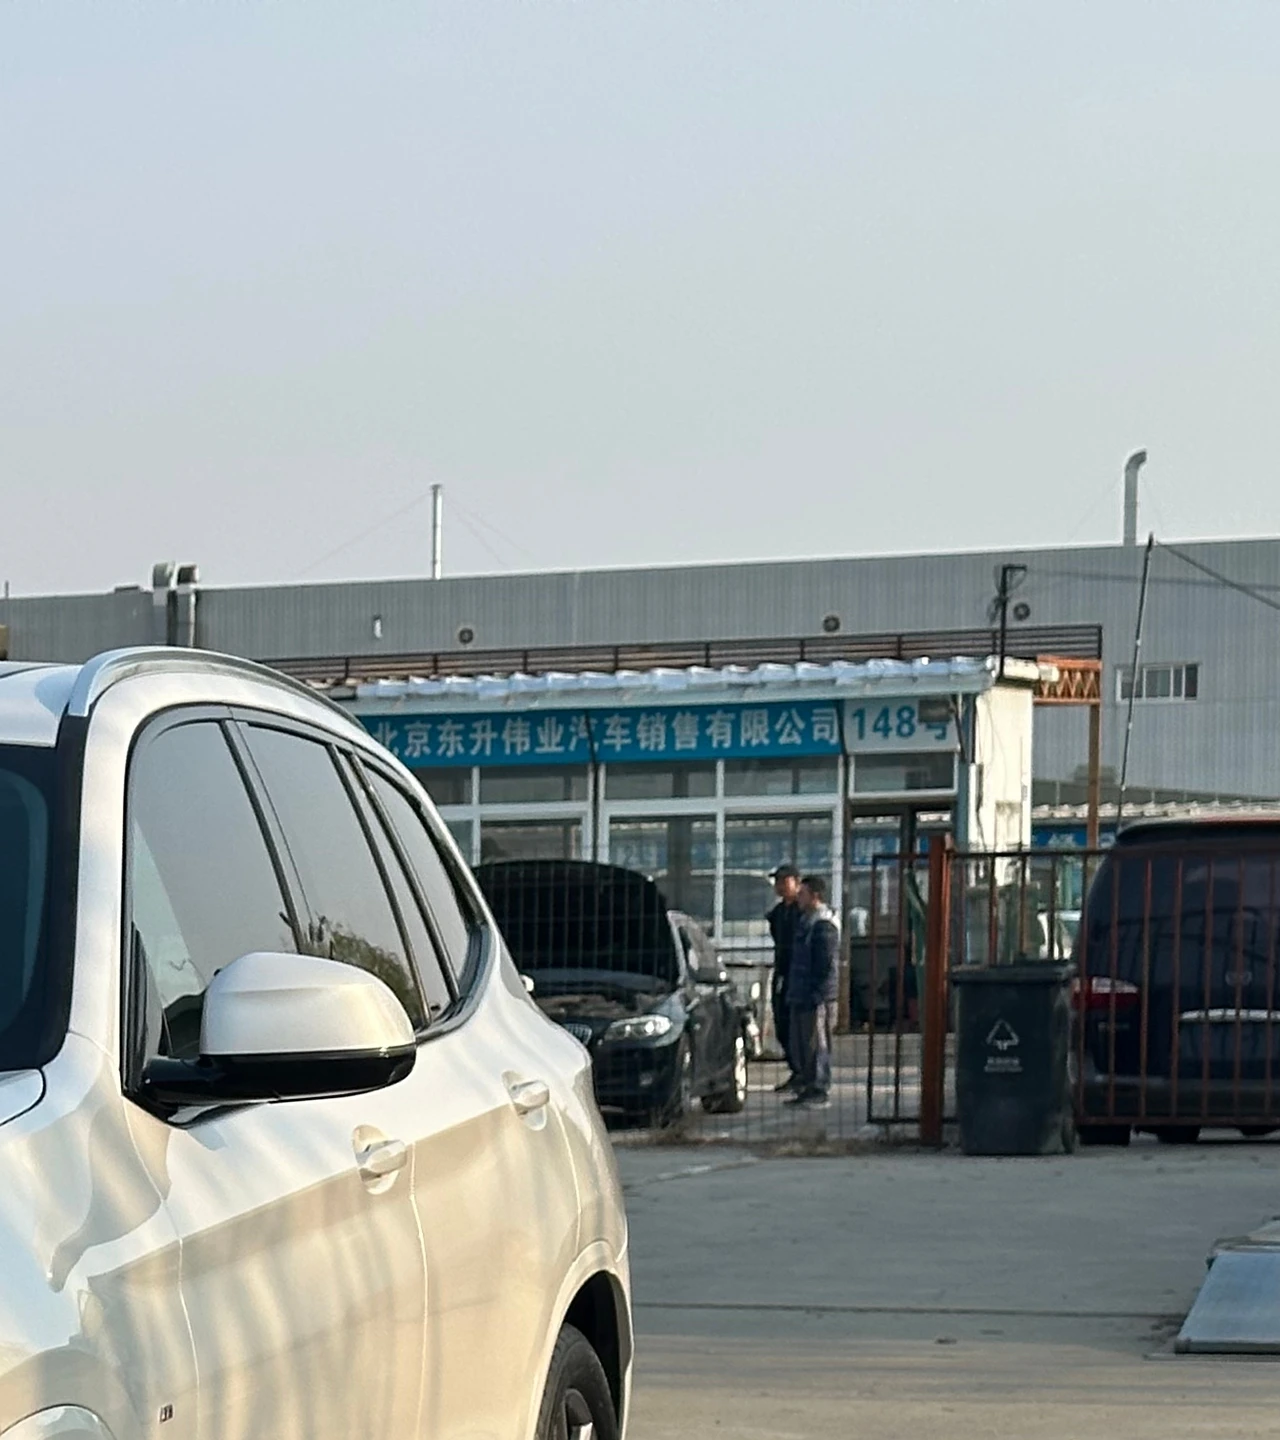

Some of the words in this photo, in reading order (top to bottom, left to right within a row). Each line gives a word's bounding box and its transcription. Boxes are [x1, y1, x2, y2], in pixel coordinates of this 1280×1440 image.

[372, 707, 839, 758] 北京东升伟业汽车销售有限公司
